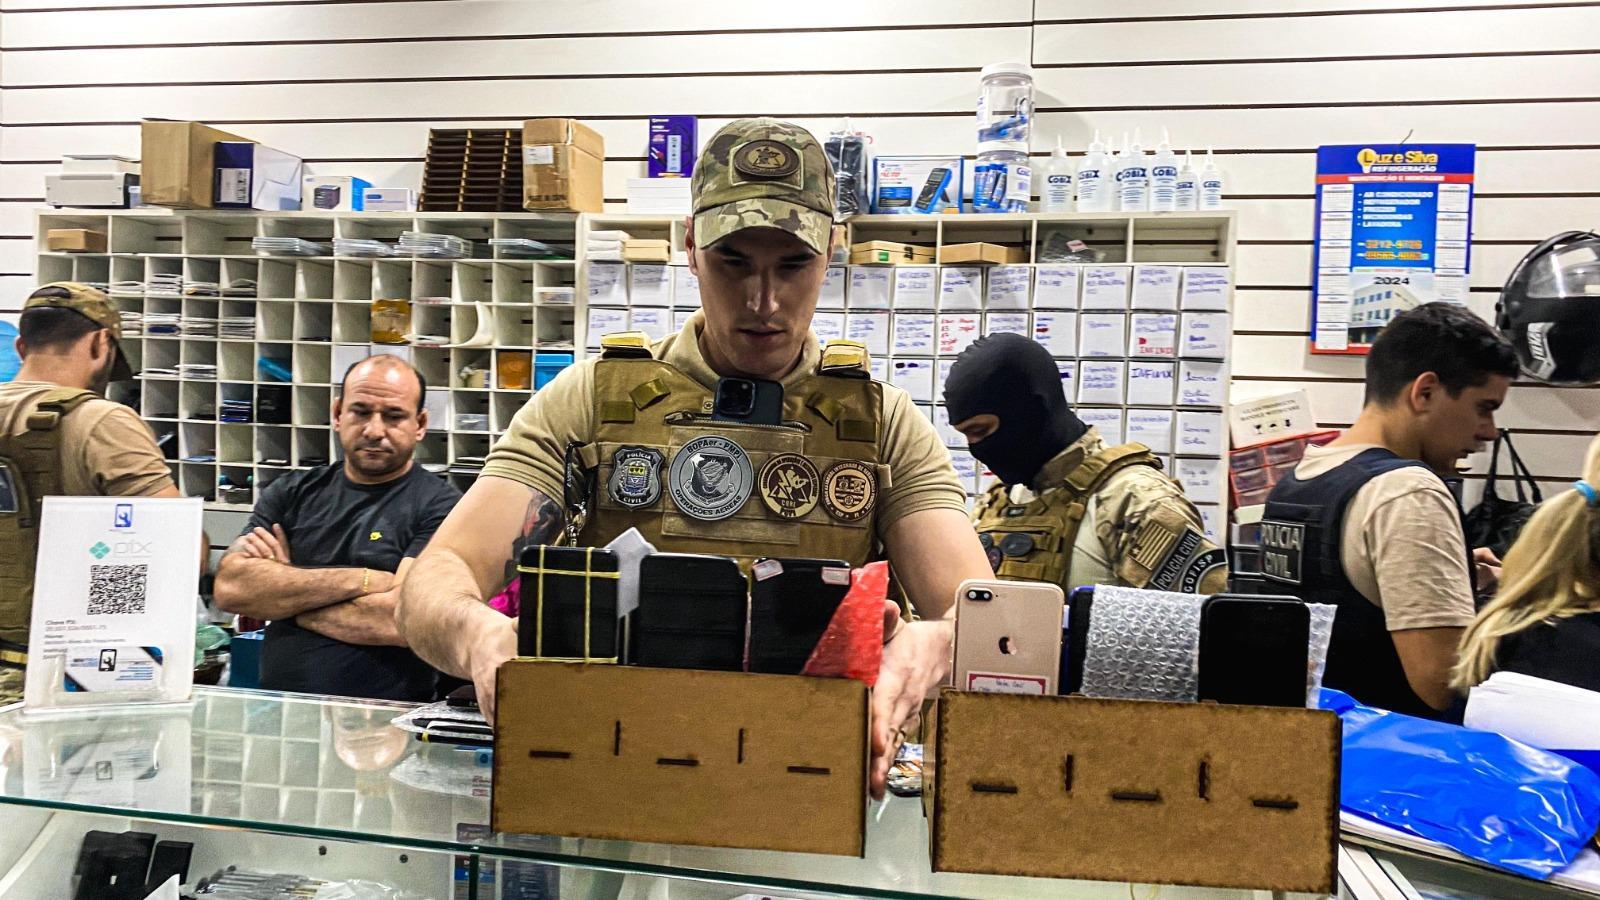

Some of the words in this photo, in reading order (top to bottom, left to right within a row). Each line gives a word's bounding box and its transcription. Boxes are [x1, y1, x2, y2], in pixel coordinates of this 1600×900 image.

[1358, 150, 1393, 164] Luz
[1394, 154, 1403, 163] e
[1405, 151, 1438, 163] Silva
[1048, 174, 1072, 184] COBIX
[1374, 276, 1410, 285] 2024
[686, 440, 718, 454] BOPAer
[723, 442, 743, 459] PMPI
[623, 496, 643, 504] CIVIL
[1157, 554, 1186, 588] POLICIA
[1178, 532, 1200, 556] CIVIL
[1264, 551, 1292, 579] CIVIL
